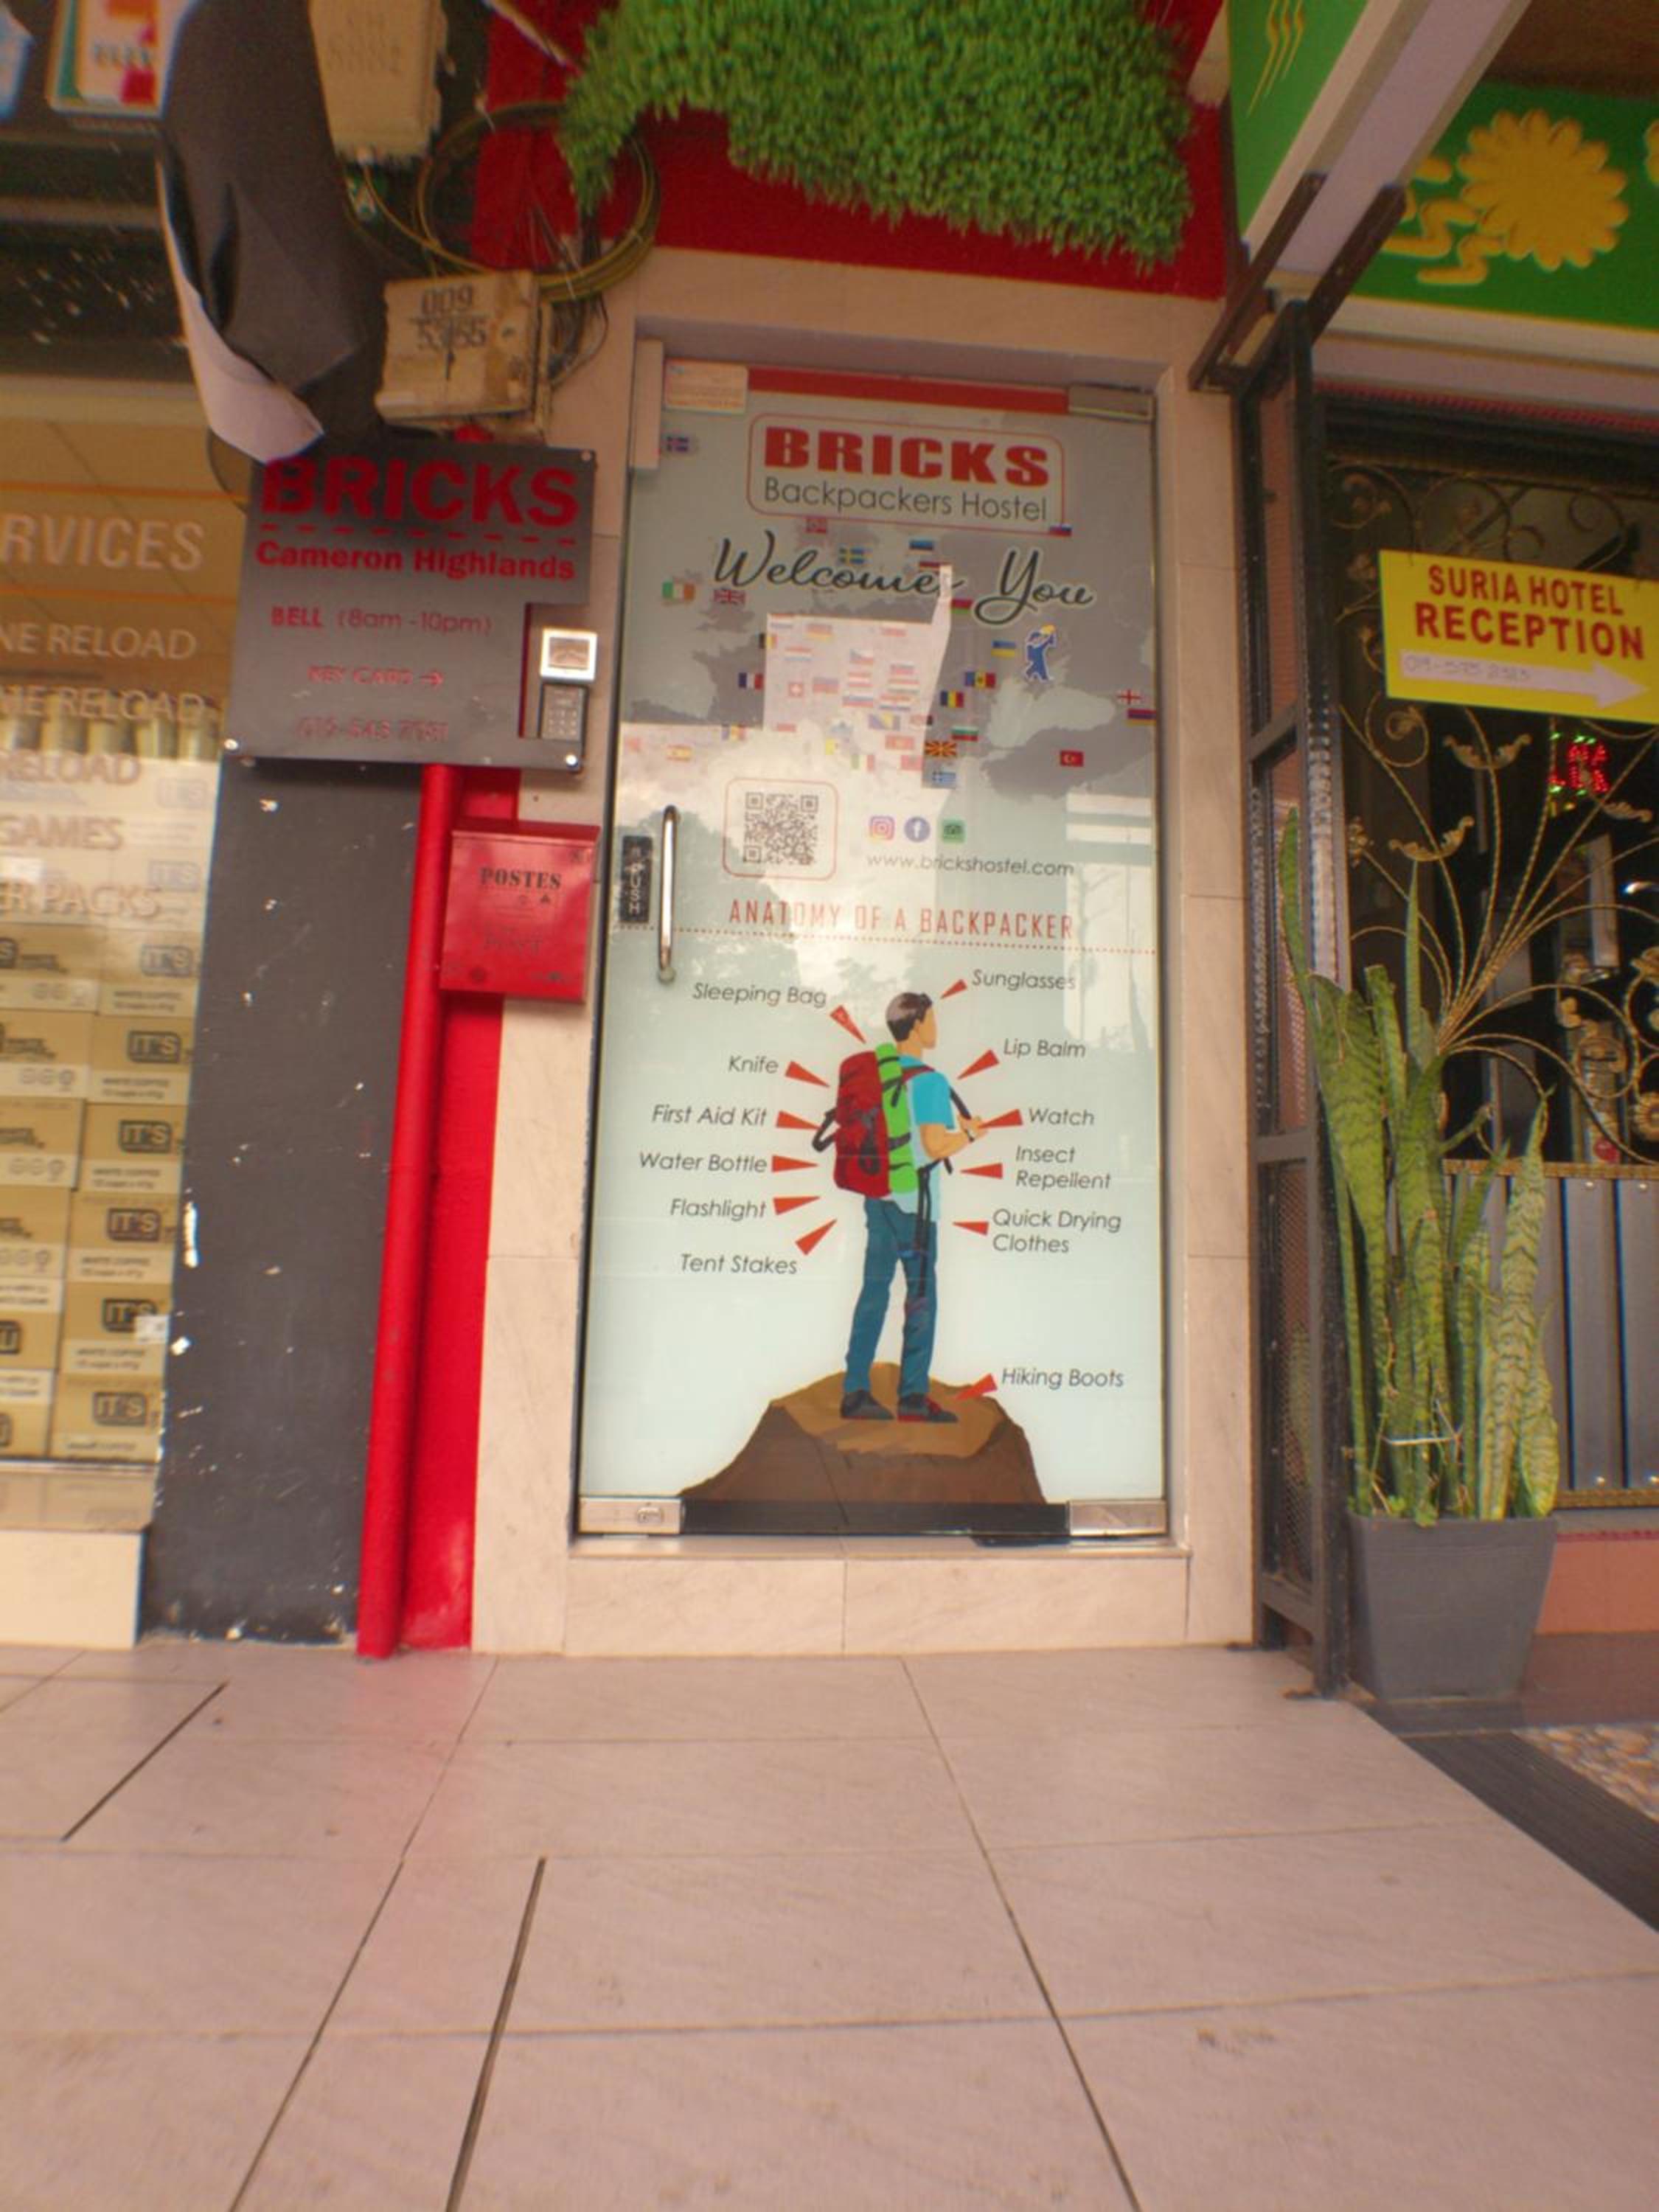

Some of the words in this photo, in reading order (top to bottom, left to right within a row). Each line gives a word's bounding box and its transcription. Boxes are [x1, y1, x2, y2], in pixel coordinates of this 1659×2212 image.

[765, 426, 1048, 488] BRICKS
[259, 455, 581, 527] BRICKS
[765, 476, 951, 515] Backpackers
[962, 493, 1047, 521] Hostel
[0, 515, 205, 571] RVICES
[255, 540, 403, 571] Cameron
[414, 547, 576, 582] Highlands
[974, 549, 1094, 625] You
[1428, 564, 1522, 604] SURIA
[1528, 576, 1624, 616] HOTEL
[271, 607, 323, 628] BELL
[46, 623, 198, 660] RELOAD
[1414, 602, 1645, 660] RECEPTION
[59, 685, 206, 723] RELOAD
[867, 853, 1075, 877] www.brickshostel.com
[481, 868, 562, 890] POSTES
[730, 898, 843, 928] ANATOMY
[855, 905, 883, 931] OF
[894, 908, 908, 931] A
[920, 908, 1073, 939] BACKPACKER
[972, 969, 1077, 991] Sunglasses
[692, 982, 781, 1006] Sleeping
[787, 987, 827, 1008] Bag
[1004, 1038, 1031, 1059] Lip
[1037, 1040, 1086, 1058] Balm
[728, 1055, 779, 1074] Knife
[652, 1105, 692, 1124] First
[697, 1106, 734, 1125] Aid
[741, 1108, 768, 1126] Kit
[1029, 1107, 1095, 1126] Watch
[639, 1152, 701, 1171] Water
[708, 1153, 768, 1174] Bottle
[1015, 1145, 1076, 1164] Insect
[1015, 1170, 1111, 1192] Repellent
[670, 1198, 767, 1222] Flashlight
[992, 1208, 1052, 1228] Quick
[1058, 1210, 1122, 1234] Drying
[992, 1234, 1070, 1253] Clothes
[681, 1254, 725, 1273] Tent
[731, 1255, 798, 1275] Stakes
[1002, 1367, 1062, 1391] Hiking
[1069, 1368, 1125, 1388] Boots
